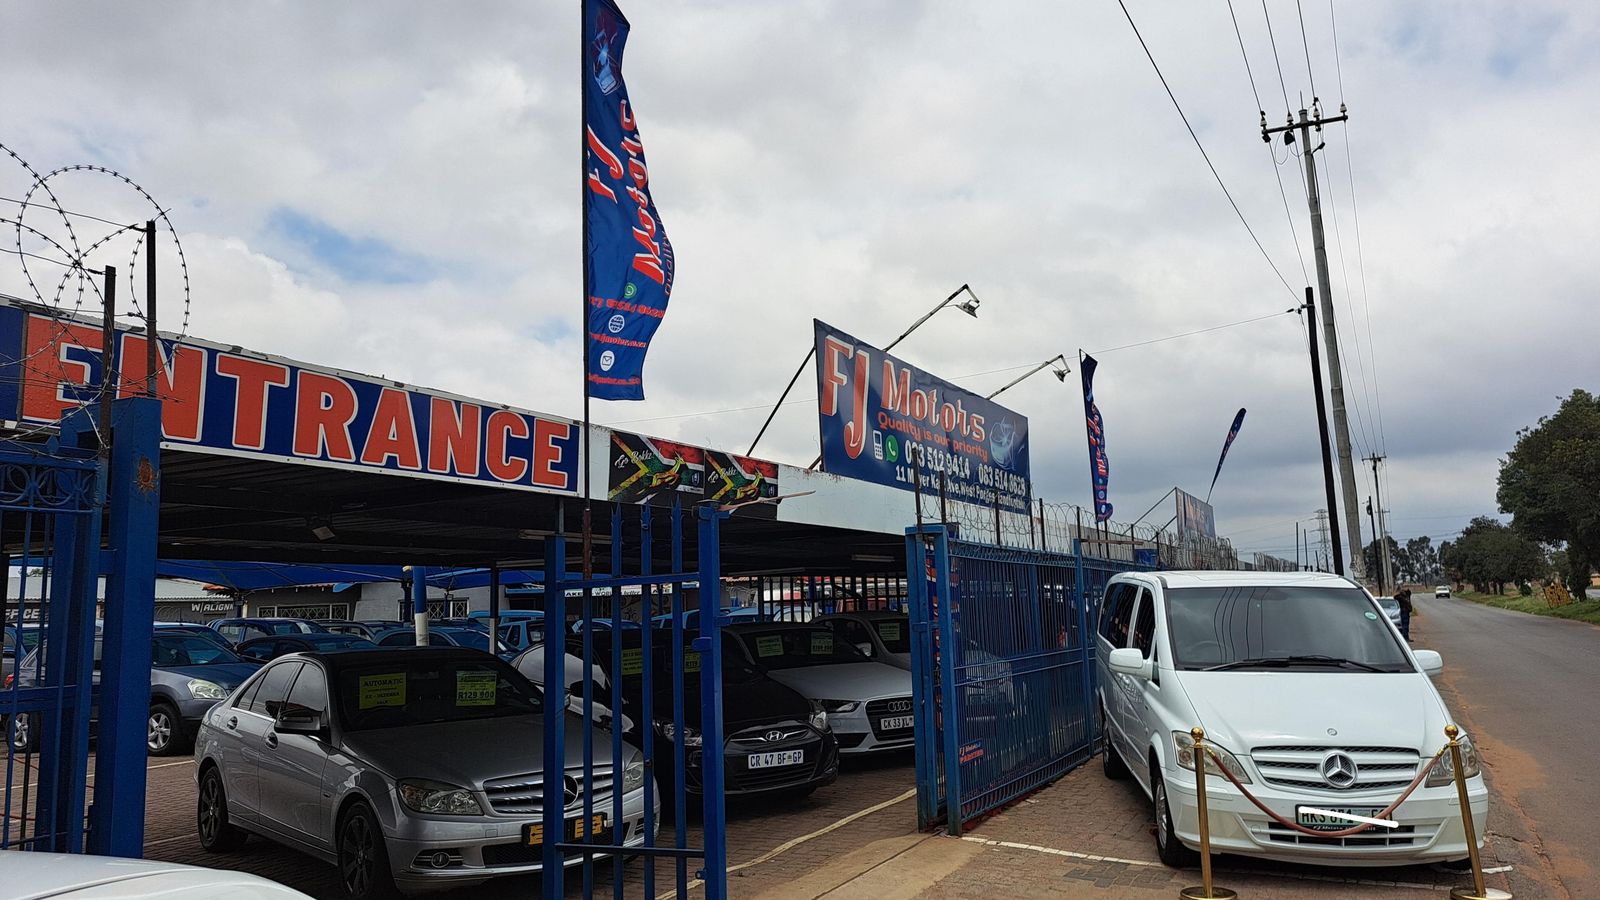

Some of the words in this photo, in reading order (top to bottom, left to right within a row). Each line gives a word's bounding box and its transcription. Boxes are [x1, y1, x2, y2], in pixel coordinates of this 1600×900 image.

[22, 313, 571, 489] ENTRANCE
[821, 335, 870, 460] FJ
[880, 359, 985, 443] Motors
[878, 411, 921, 442] Quality
[922, 429, 933, 440] is
[933, 433, 951, 447] our
[952, 439, 989, 463] priority
[895, 464, 906, 482] 11
[907, 467, 930, 489] Myer
[904, 439, 925, 468] 03
[927, 446, 944, 472] 512
[946, 452, 971, 480] 9414
[994, 468, 1008, 491] 514
[883, 719, 892, 729] CK
[892, 718, 901, 728] 33
[750, 755, 761, 767] CR
[764, 754, 774, 766] 47
[777, 752, 787, 765] BF
[792, 751, 802, 763] GP
